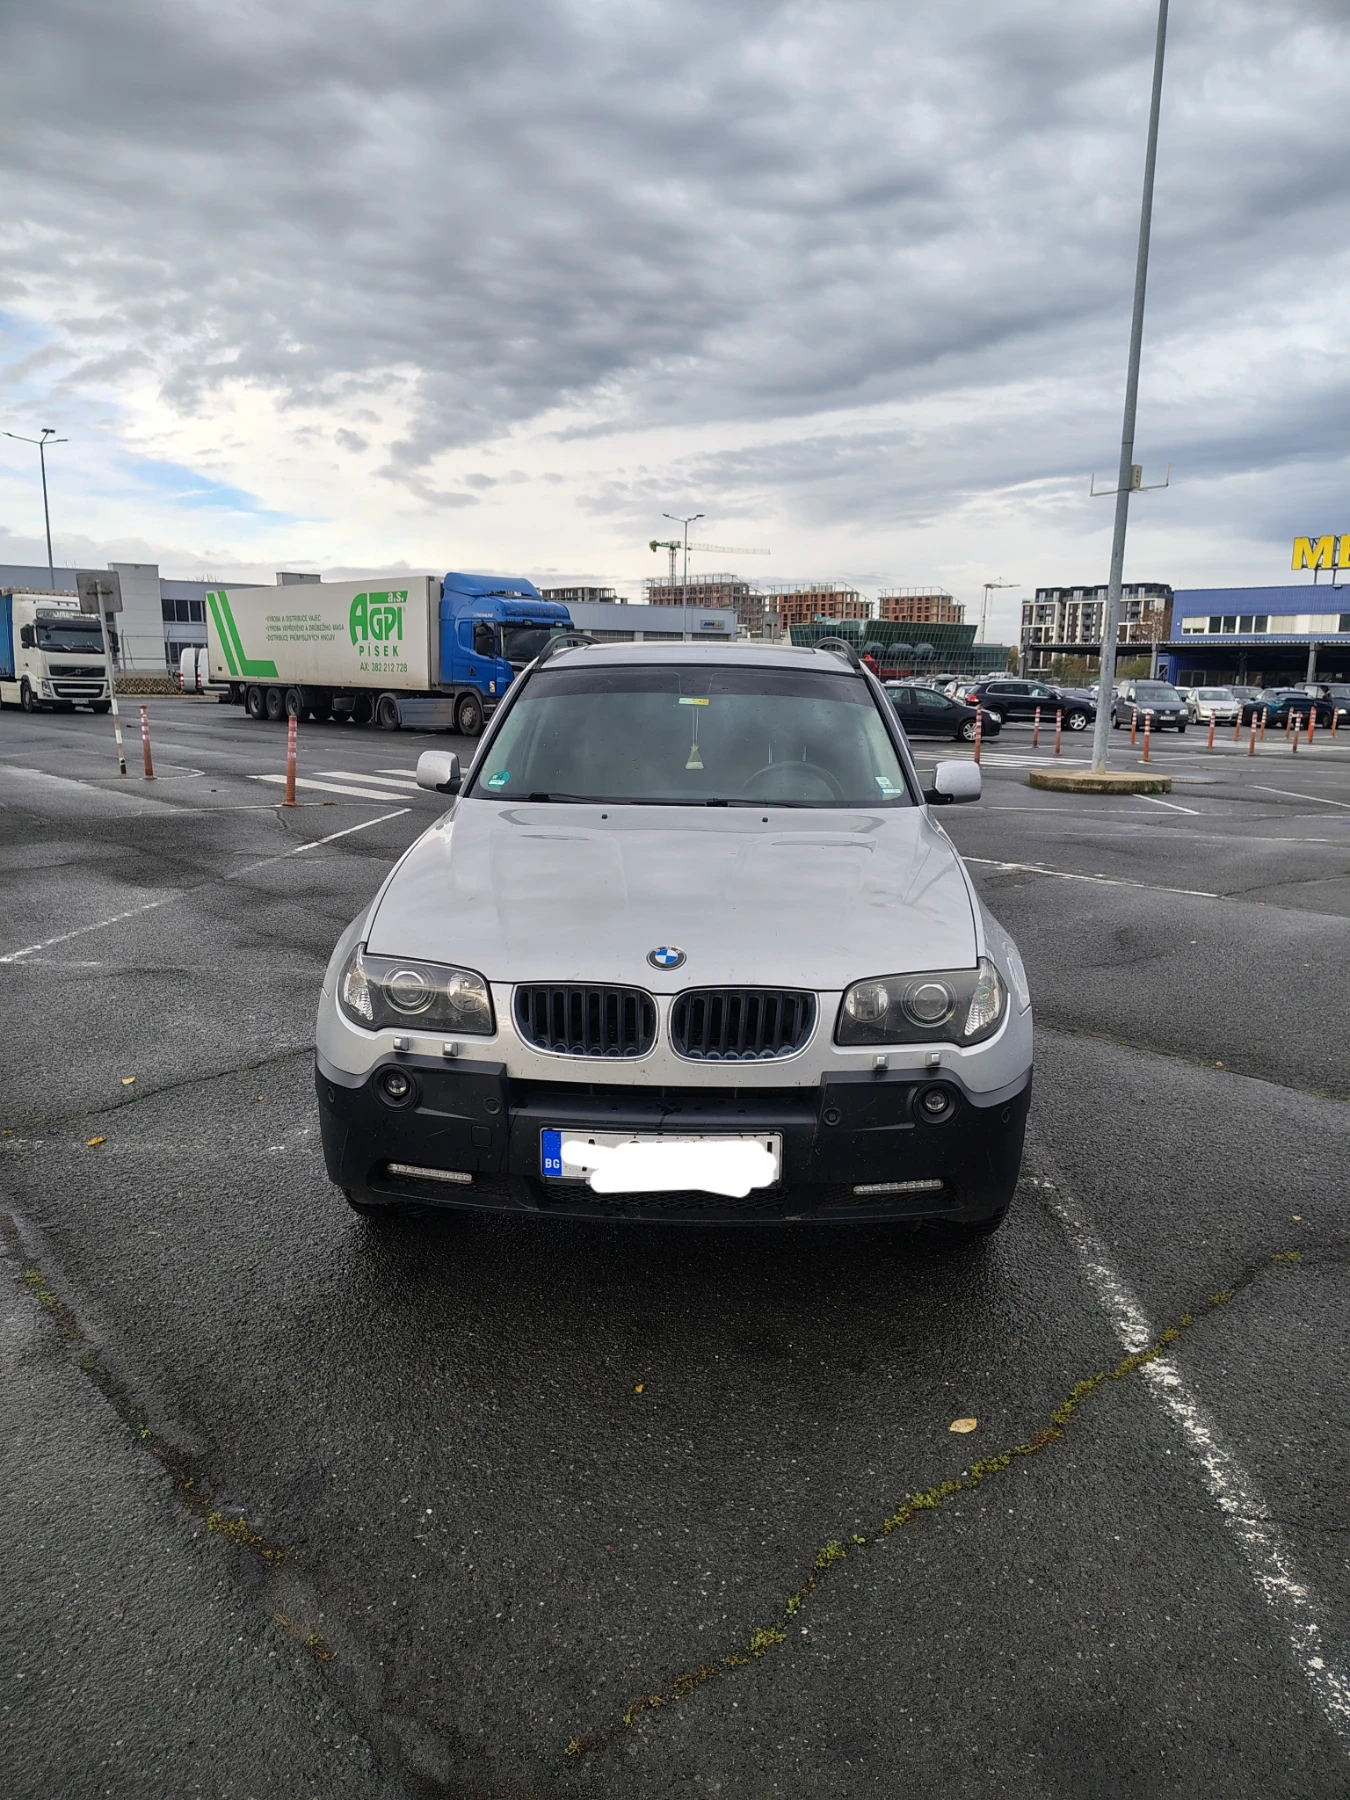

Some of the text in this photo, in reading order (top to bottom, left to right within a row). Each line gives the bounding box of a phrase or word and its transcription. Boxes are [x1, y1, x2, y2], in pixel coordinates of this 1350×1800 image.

[388, 591, 404, 603] a.s.
[350, 593, 403, 647] AGPI
[359, 642, 399, 657] PÍSEK
[371, 662, 382, 672] 382
[384, 662, 395, 673] 212
[396, 663, 408, 673] 728
[545, 1157, 561, 1169] BG
